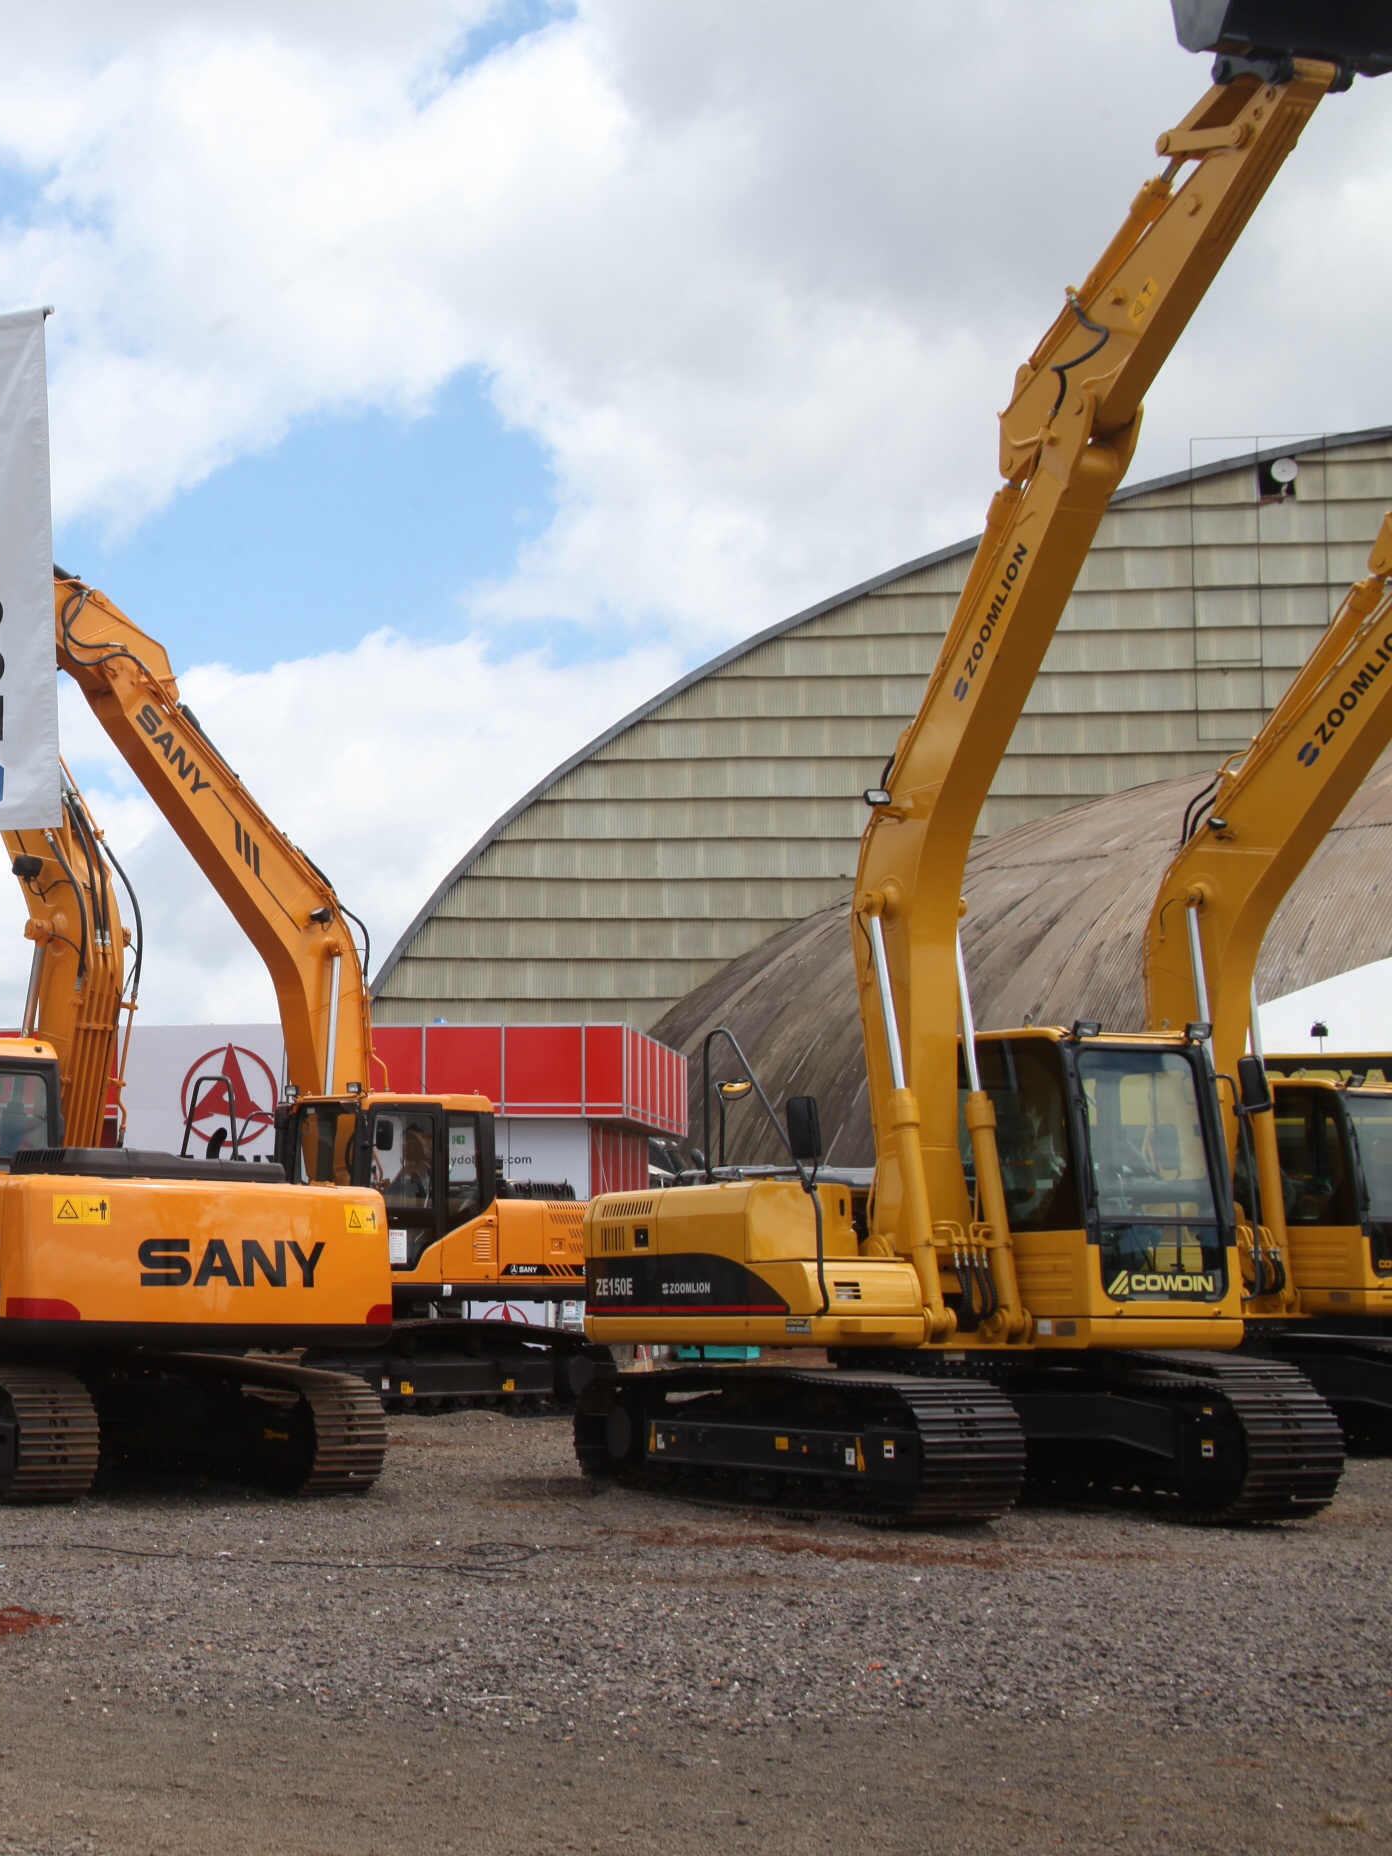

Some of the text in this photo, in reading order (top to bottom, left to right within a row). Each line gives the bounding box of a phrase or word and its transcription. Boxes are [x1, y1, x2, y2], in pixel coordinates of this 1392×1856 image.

[964, 542, 1028, 679] ZOOMLION
[135, 704, 212, 795] SANY
[138, 1238, 326, 1288] SANY
[596, 1278, 633, 1296] ZE150E
[669, 1282, 711, 1294] ZOOMLION
[1131, 1274, 1214, 1292] COWDIN
